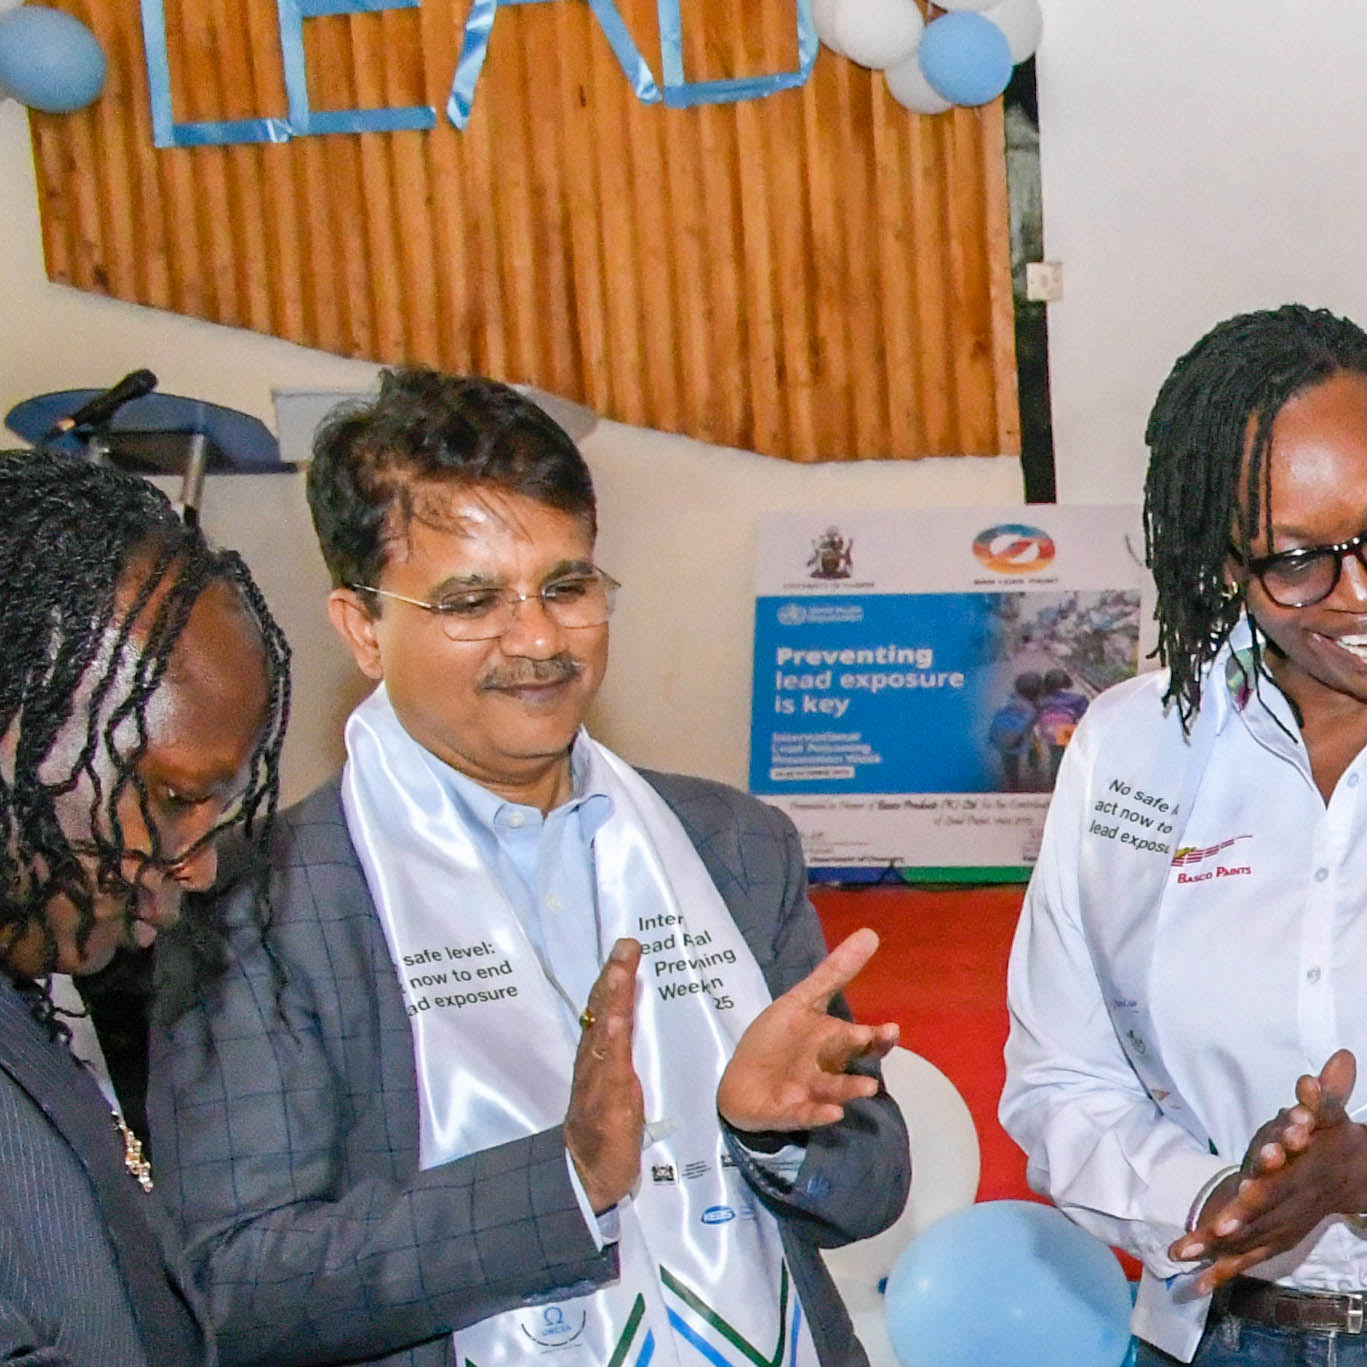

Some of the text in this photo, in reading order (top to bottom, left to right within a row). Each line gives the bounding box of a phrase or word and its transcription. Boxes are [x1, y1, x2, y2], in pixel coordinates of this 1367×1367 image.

[776, 646, 933, 670] Preventing
[776, 669, 965, 693] lead exposure
[775, 695, 850, 718] is key
[1108, 778, 1170, 813] No safe
[1089, 819, 1120, 839] lead
[1094, 800, 1173, 834] act now to
[402, 941, 496, 966] safe level:
[641, 934, 676, 955] ead
[409, 960, 513, 989] now to end
[434, 985, 518, 1008] exposure
